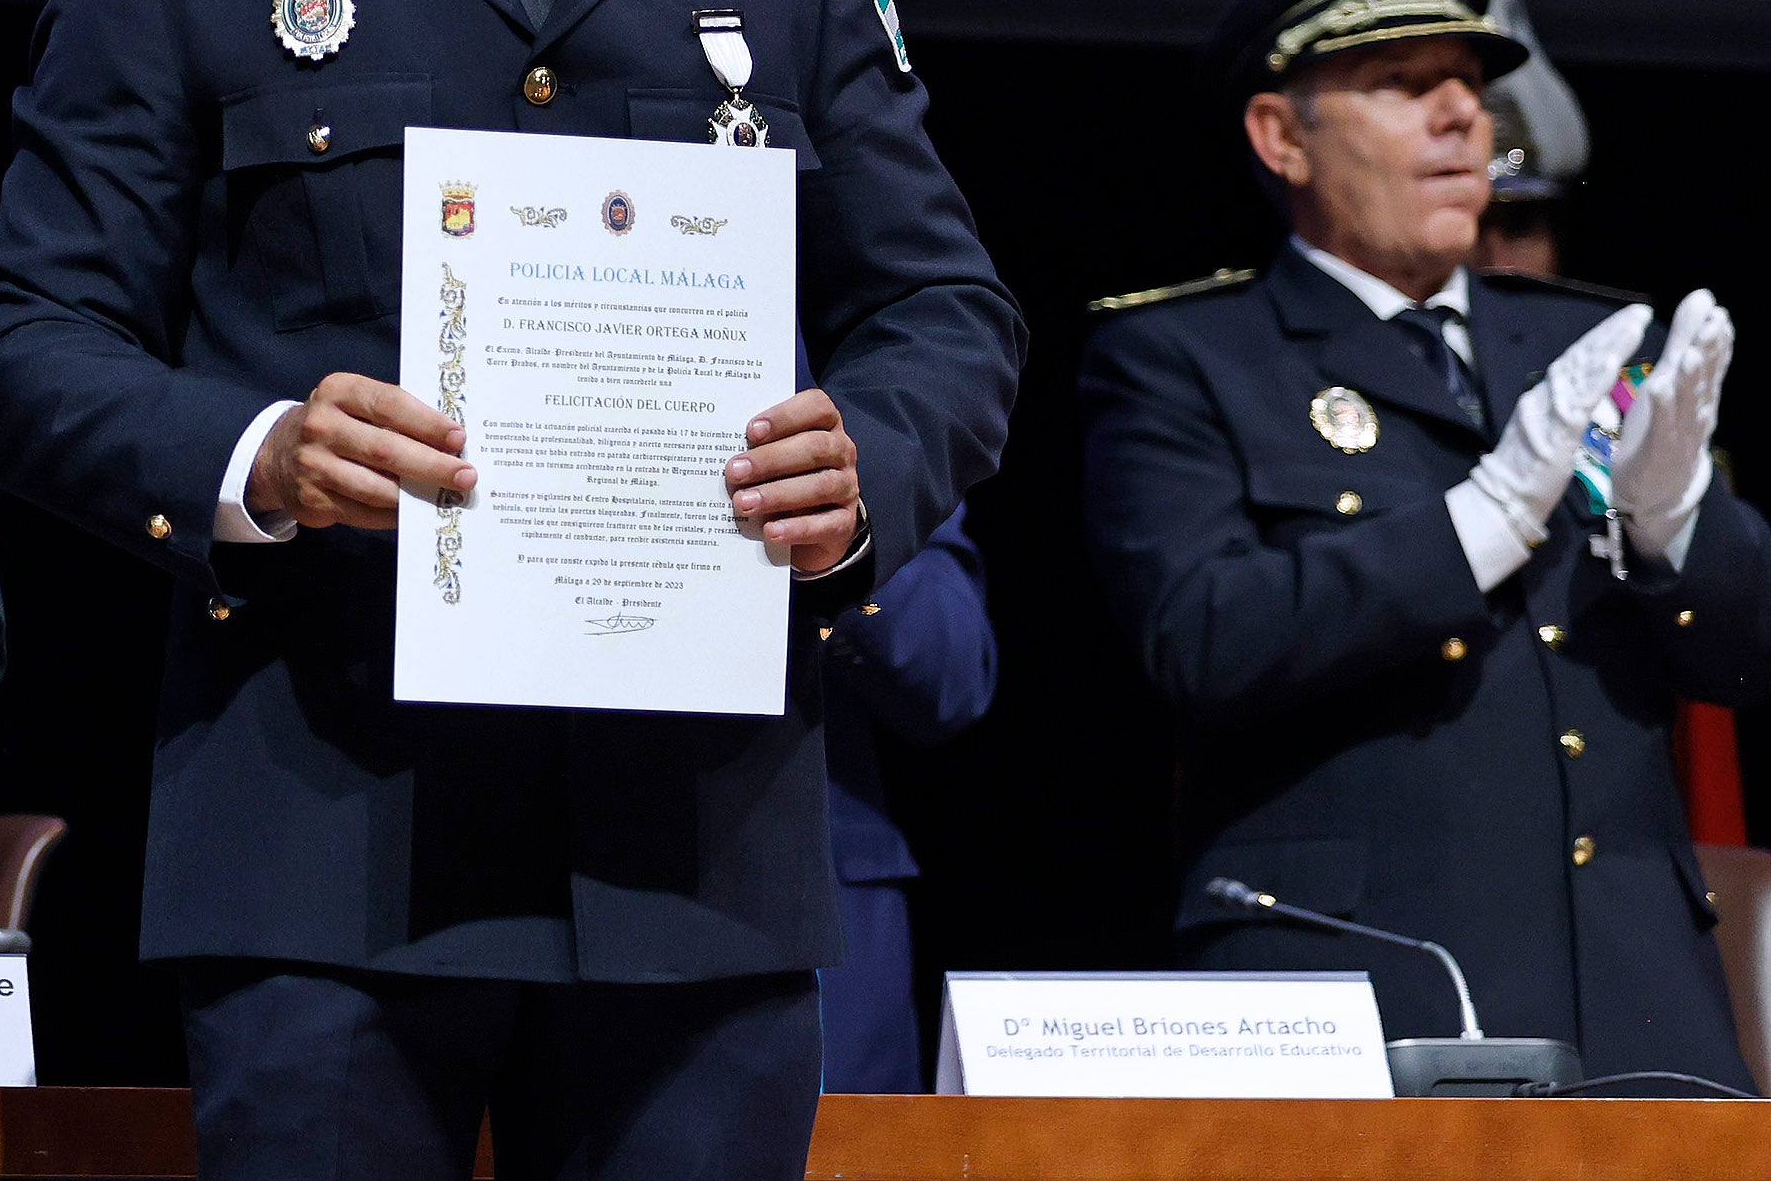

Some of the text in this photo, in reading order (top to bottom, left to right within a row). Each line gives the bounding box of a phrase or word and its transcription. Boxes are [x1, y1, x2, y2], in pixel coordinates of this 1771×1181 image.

[592, 266, 655, 285] LOCAL
[659, 268, 746, 291] MÁLAGA
[502, 318, 748, 342] D. FRANCISCO JAVIER ORTEGA MOÑUX
[544, 394, 716, 414] FELICITACIÓN DEL CUERPO
[1041, 1017, 1124, 1041] Miguel
[1134, 1017, 1229, 1036] Briones
[1238, 1017, 1337, 1036] Artacho
[986, 1043, 1363, 1060] Delegado Territorial de Desarrollo Educativo
